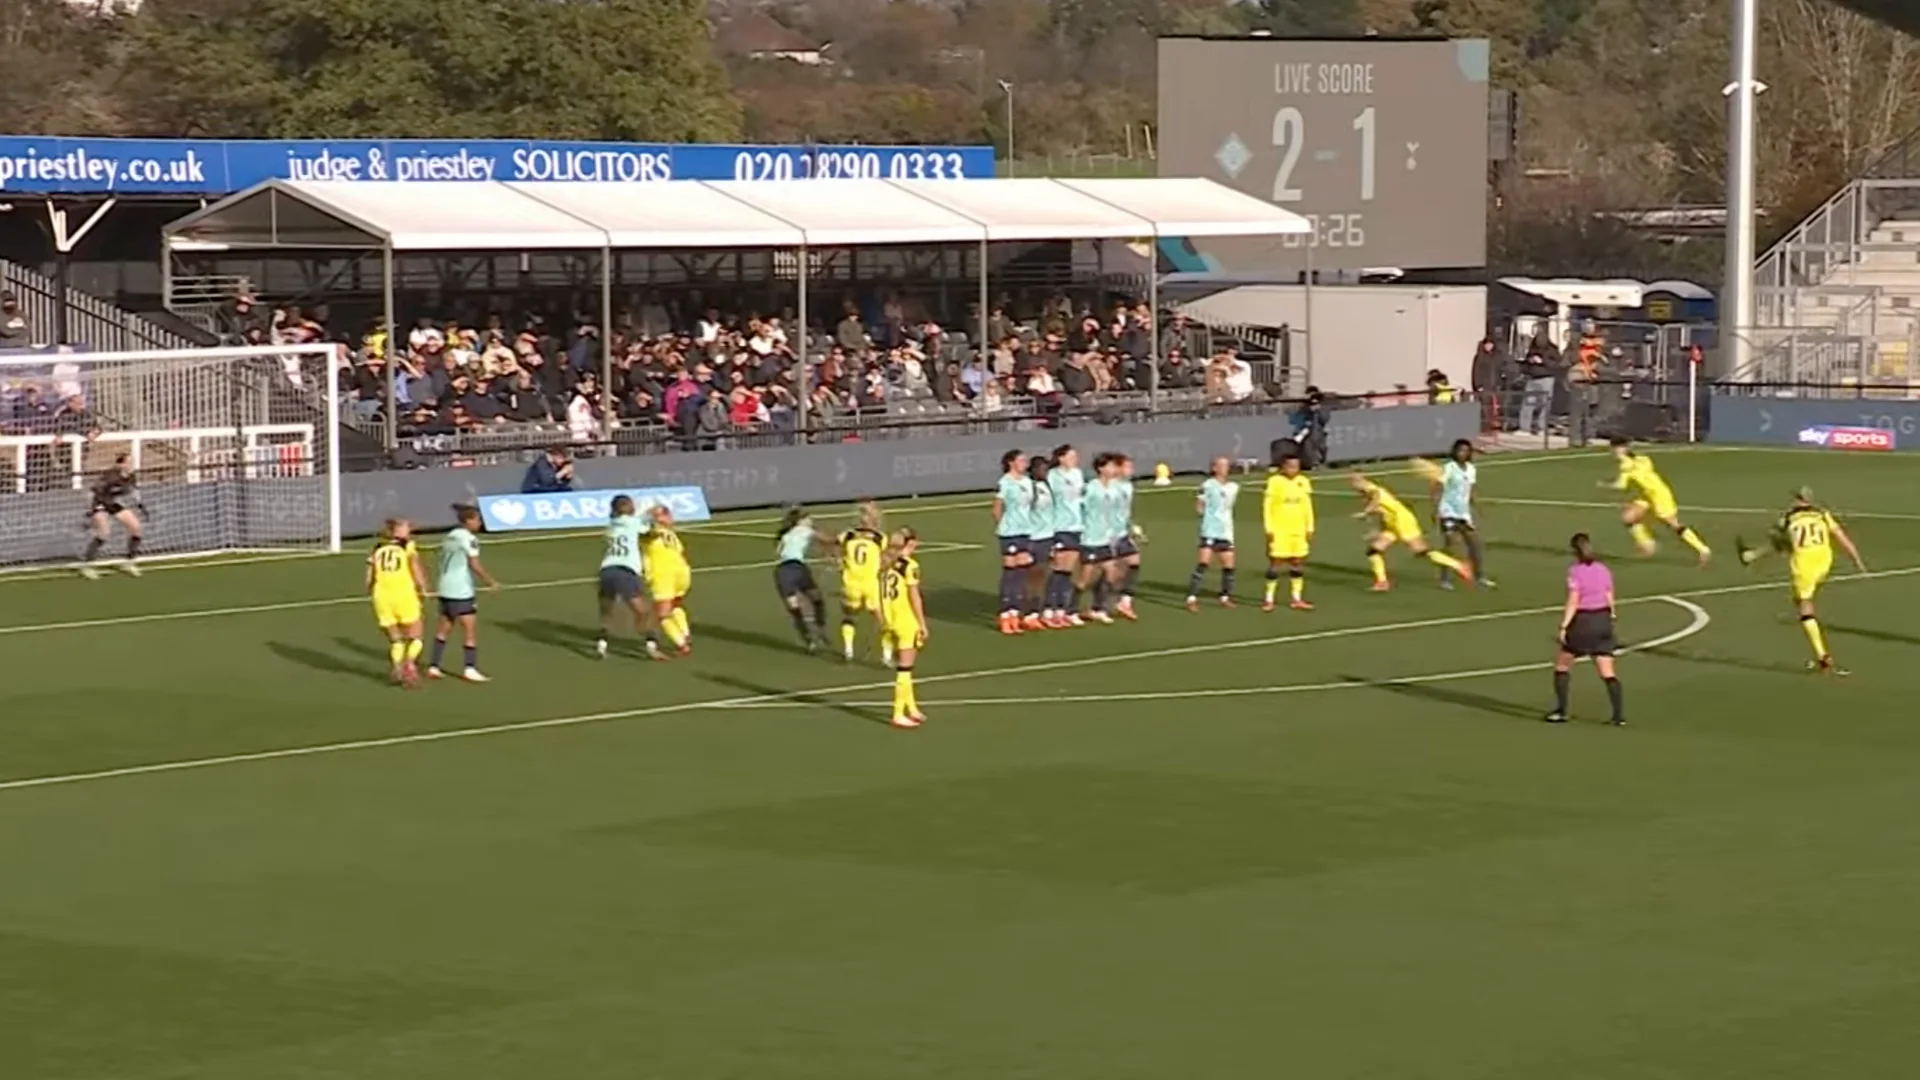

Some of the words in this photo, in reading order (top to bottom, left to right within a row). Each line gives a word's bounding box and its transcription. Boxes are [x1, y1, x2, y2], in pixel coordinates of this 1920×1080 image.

[1274, 63, 1312, 94] LIVE
[1318, 63, 1375, 94] SCORE
[0, 148, 205, 189] priestley.co.uk
[287, 149, 361, 181] judge
[367, 148, 388, 180] &
[396, 149, 496, 181] priestley
[512, 148, 672, 181] SOLICITORS
[734, 151, 793, 181] 020
[890, 151, 965, 181] 0333
[1272, 106, 1304, 201] 2
[1353, 106, 1376, 201] 1
[1798, 427, 1830, 445] sky
[1833, 431, 1889, 446] sports
[854, 542, 867, 566] 6
[881, 573, 900, 601] 13
